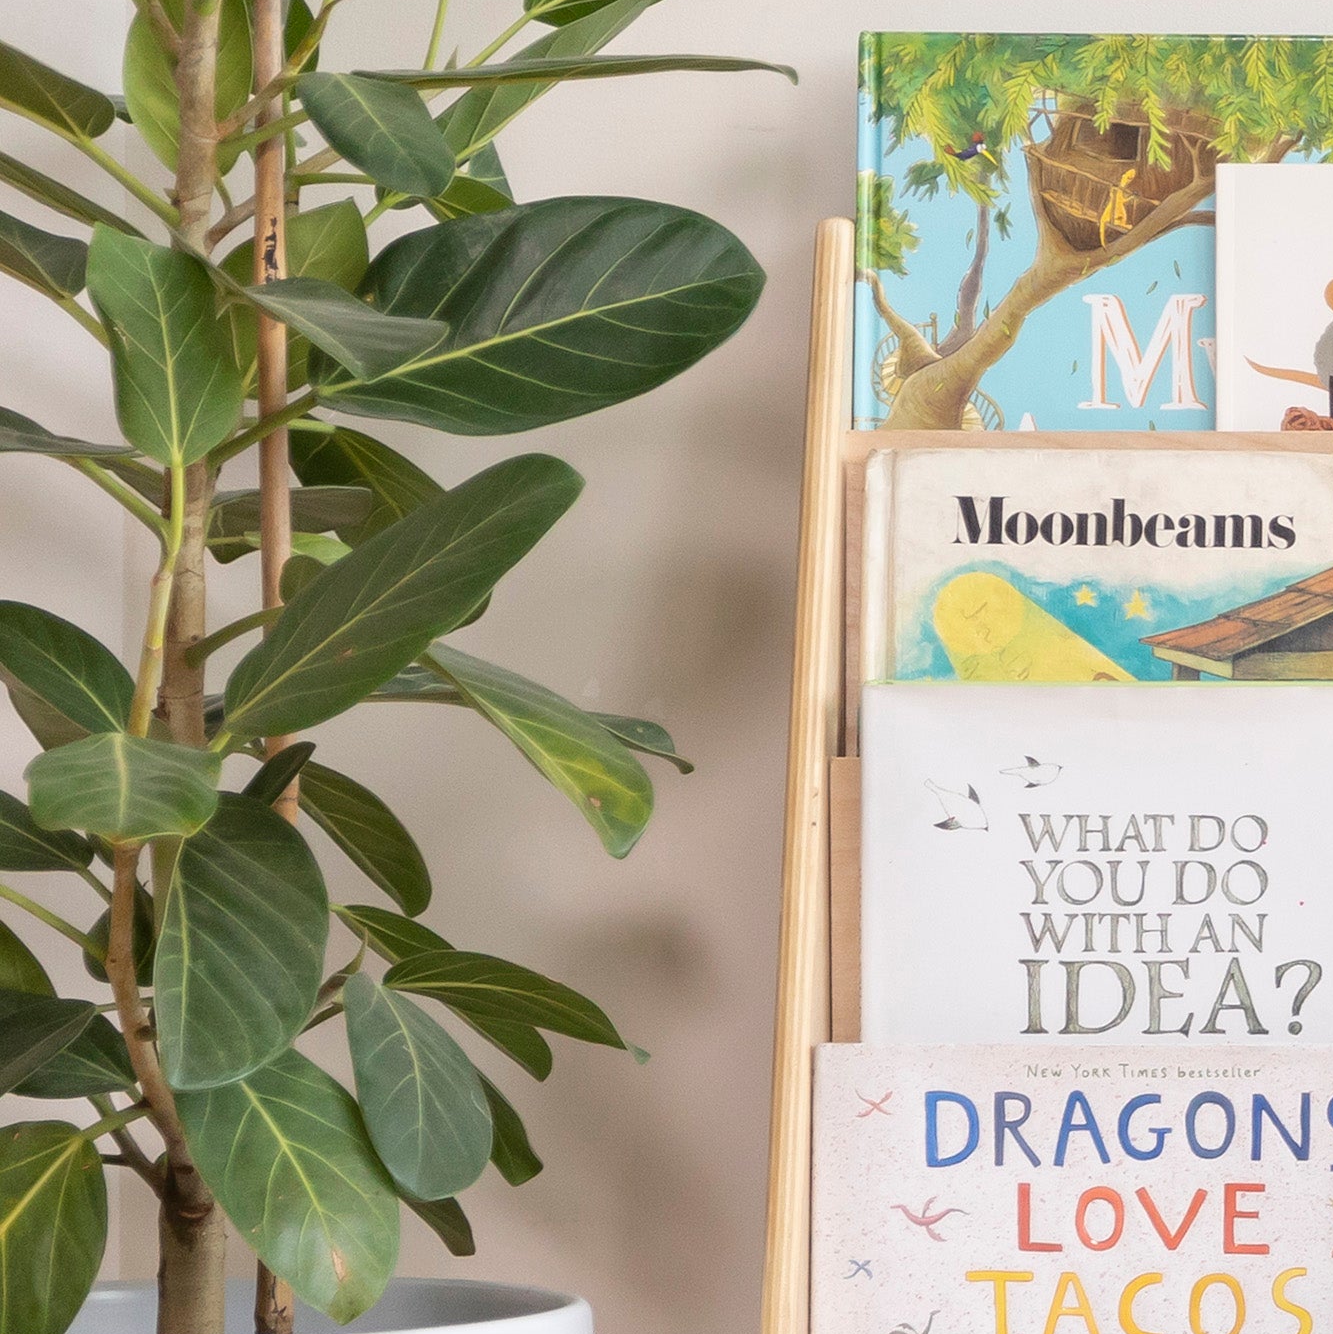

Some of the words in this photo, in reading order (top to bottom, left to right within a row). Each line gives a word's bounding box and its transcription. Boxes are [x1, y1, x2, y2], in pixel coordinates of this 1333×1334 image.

[1077, 293, 1216, 410] M
[952, 495, 1296, 550] Moonbeams
[1018, 813, 1175, 852] WHAT
[1188, 814, 1269, 852] DO
[1019, 859, 1149, 906] YOU
[1172, 860, 1268, 905] DO
[1019, 912, 1173, 953] WITH
[1189, 913, 1267, 953] AN
[1018, 957, 1323, 1038] IDEA?
[1026, 1065, 1062, 1078] NEW
[1071, 1064, 1110, 1078] YORK
[1119, 1063, 1167, 1078] TIMES
[1178, 1067, 1261, 1078] bestseller
[1017, 1182, 1270, 1255] LOVE
